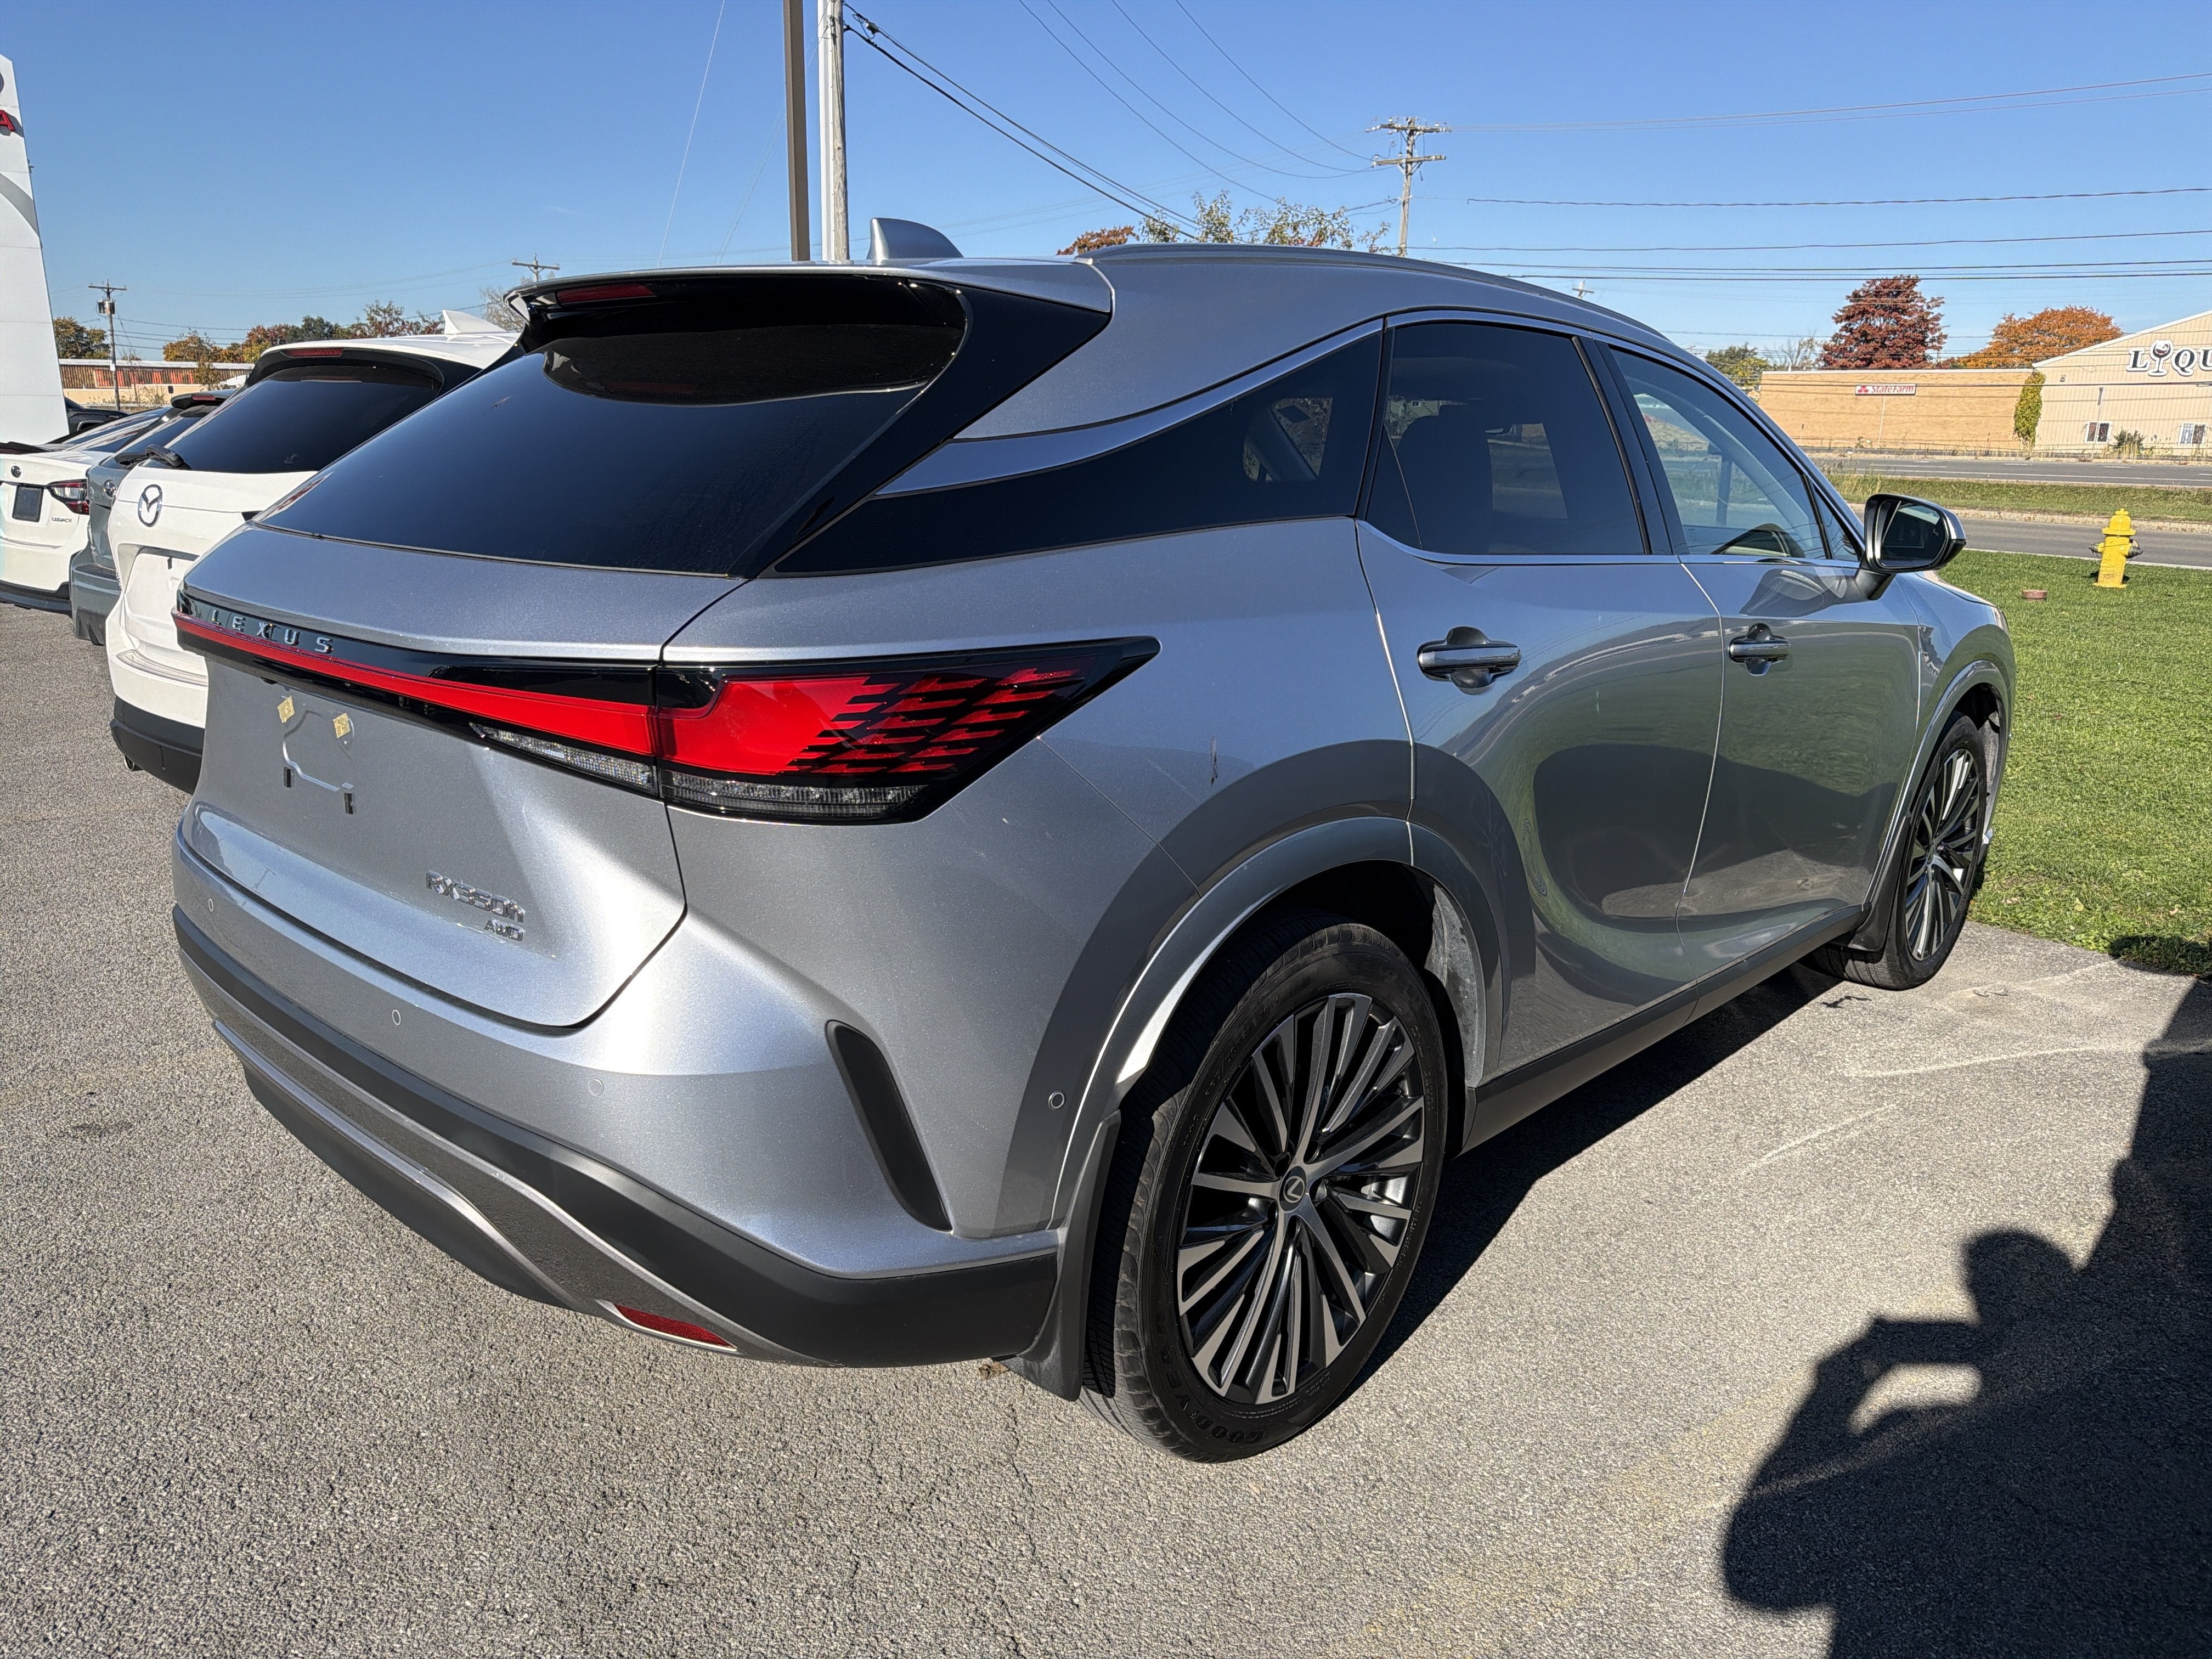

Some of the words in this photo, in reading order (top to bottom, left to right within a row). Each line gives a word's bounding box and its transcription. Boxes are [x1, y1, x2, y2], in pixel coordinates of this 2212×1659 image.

[211, 609, 334, 654] LEXUS
[426, 869, 525, 923] RX350h
[484, 918, 524, 941] AWD
